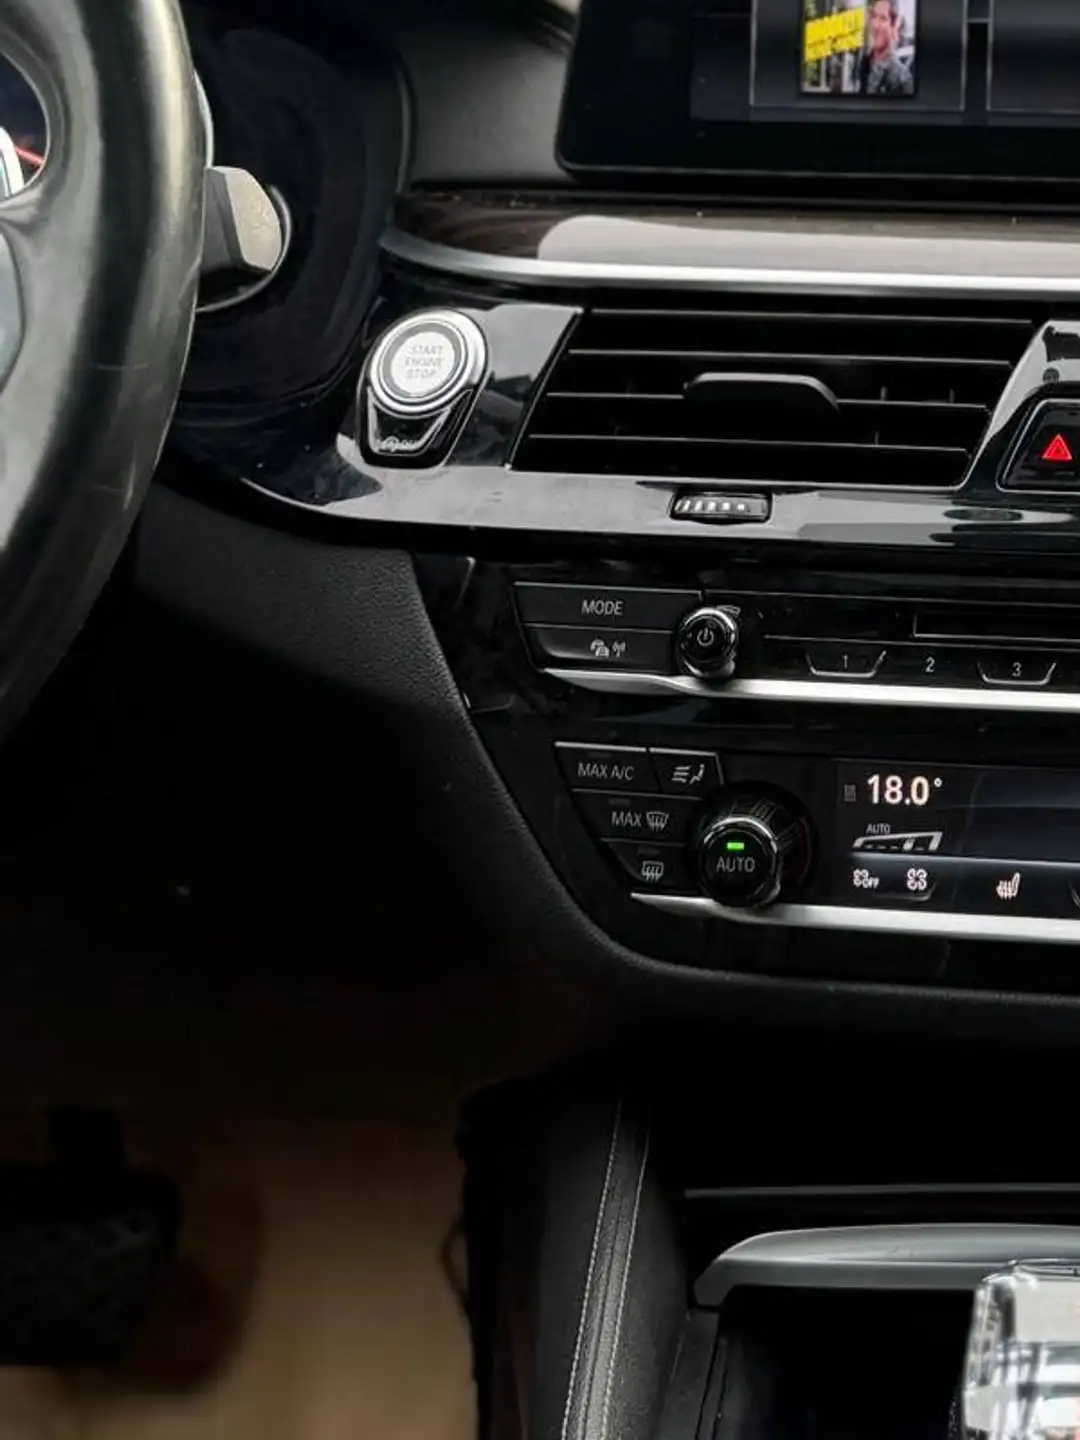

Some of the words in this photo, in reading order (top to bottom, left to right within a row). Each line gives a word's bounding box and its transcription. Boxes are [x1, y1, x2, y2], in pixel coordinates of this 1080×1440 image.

[581, 599, 624, 616] MODE
[842, 655, 849, 669] 1
[925, 657, 935, 673] 2
[1011, 663, 1022, 678] 3
[578, 762, 608, 778] MAX
[611, 765, 635, 781] A/C
[867, 774, 943, 806] 18.0°
[611, 811, 642, 828] MAX
[866, 822, 891, 835] AUTO
[716, 856, 756, 873] AUTO
